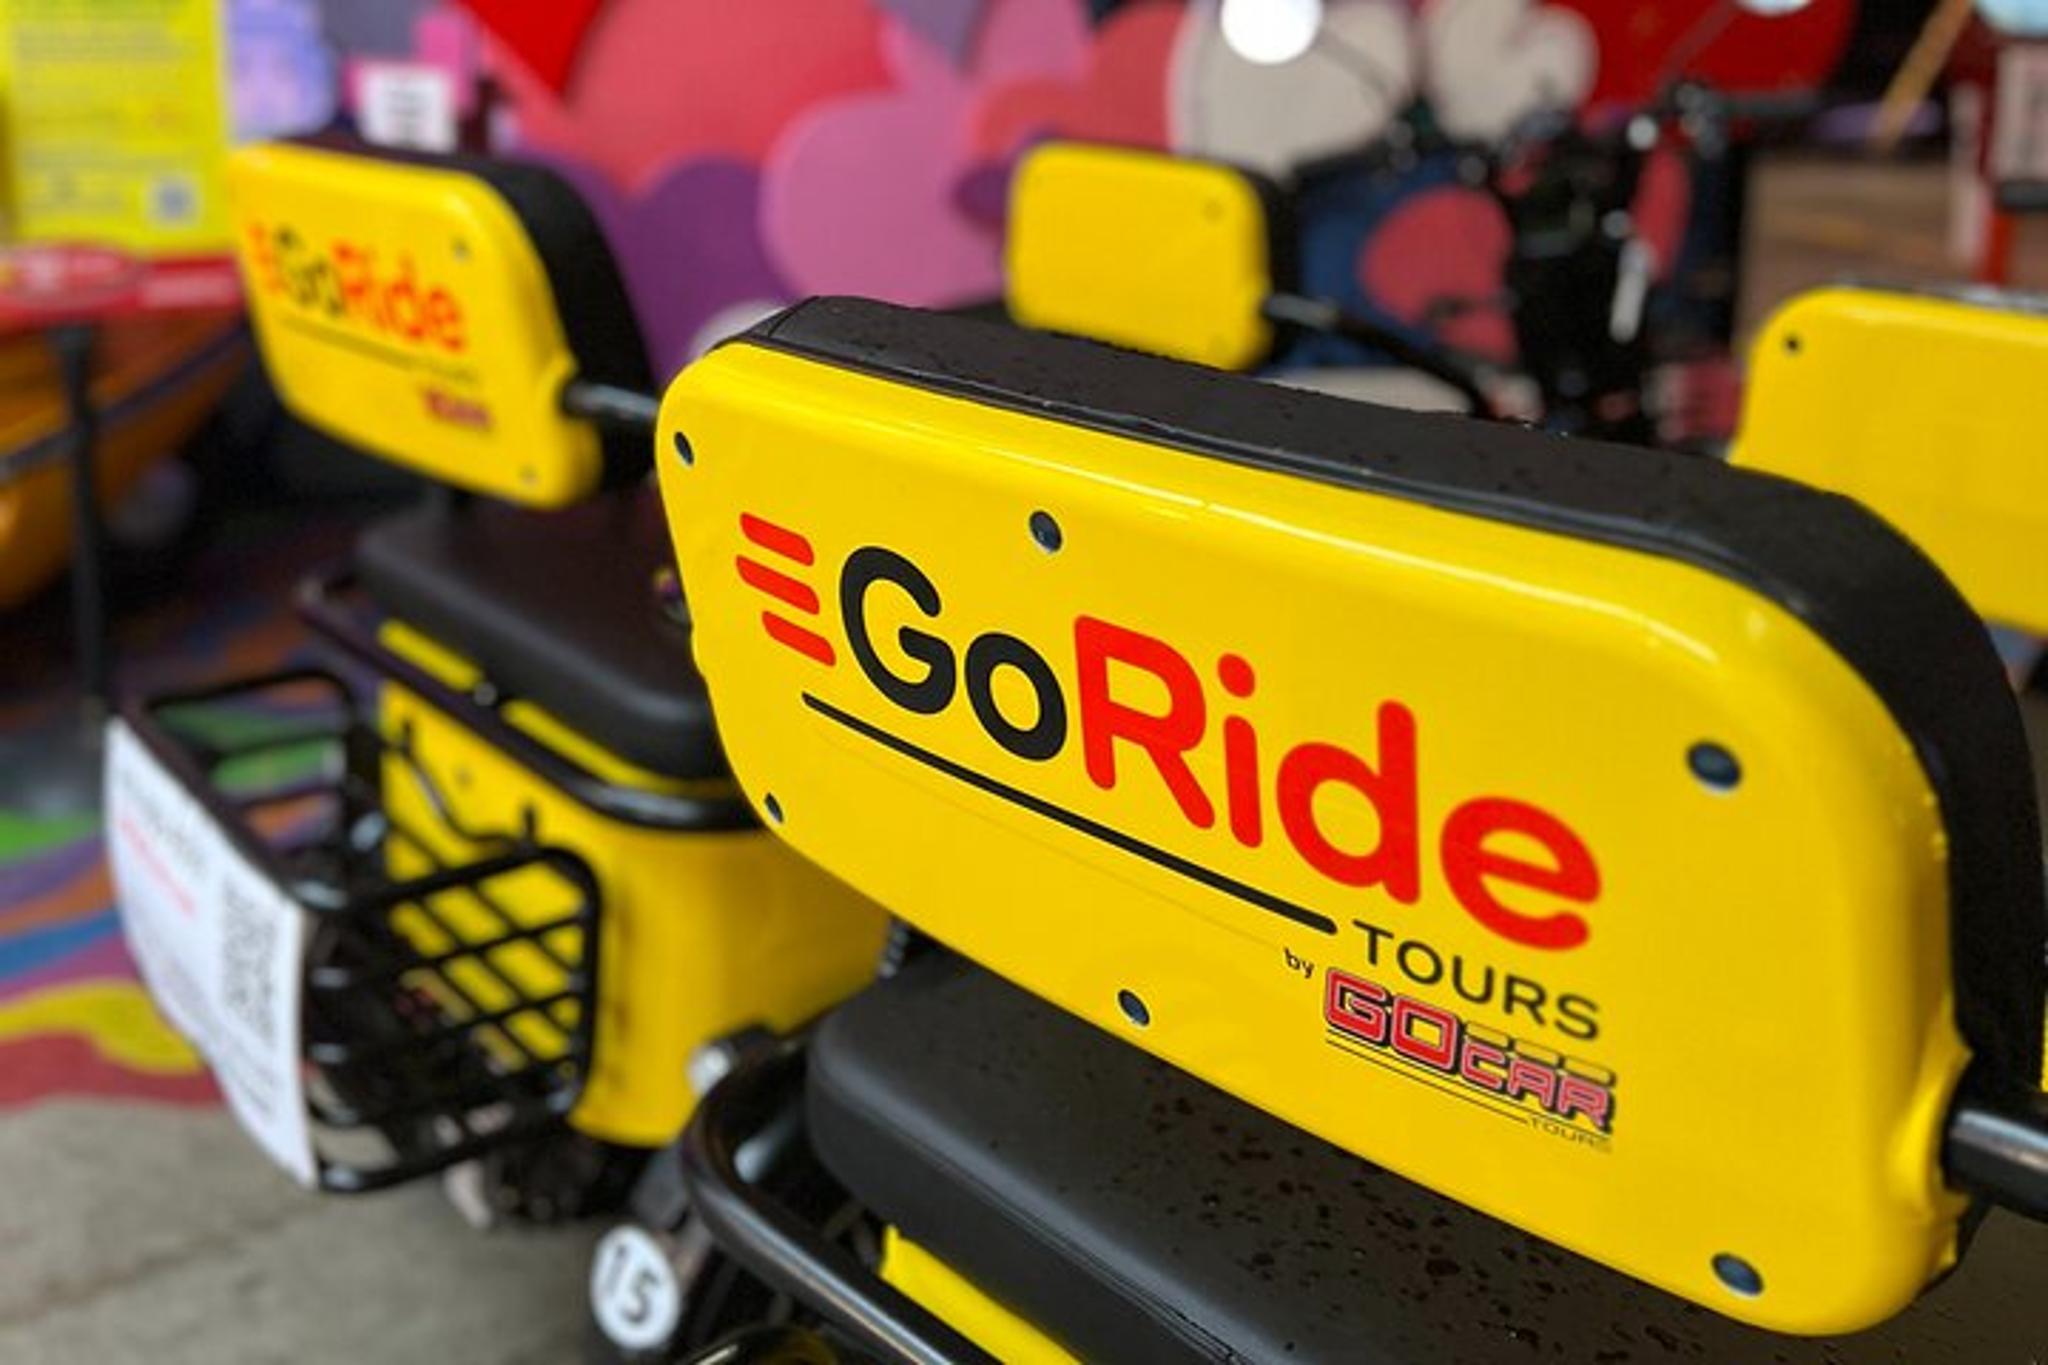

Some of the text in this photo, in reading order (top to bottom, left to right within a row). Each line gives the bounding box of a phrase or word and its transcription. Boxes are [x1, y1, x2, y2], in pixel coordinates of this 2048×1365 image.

[839, 545, 1602, 951] GoRide
[1284, 947, 1315, 979] by
[1352, 918, 1600, 1041] TOURS
[1527, 1116, 1613, 1154] TOURS
[606, 1242, 662, 1327] 15
